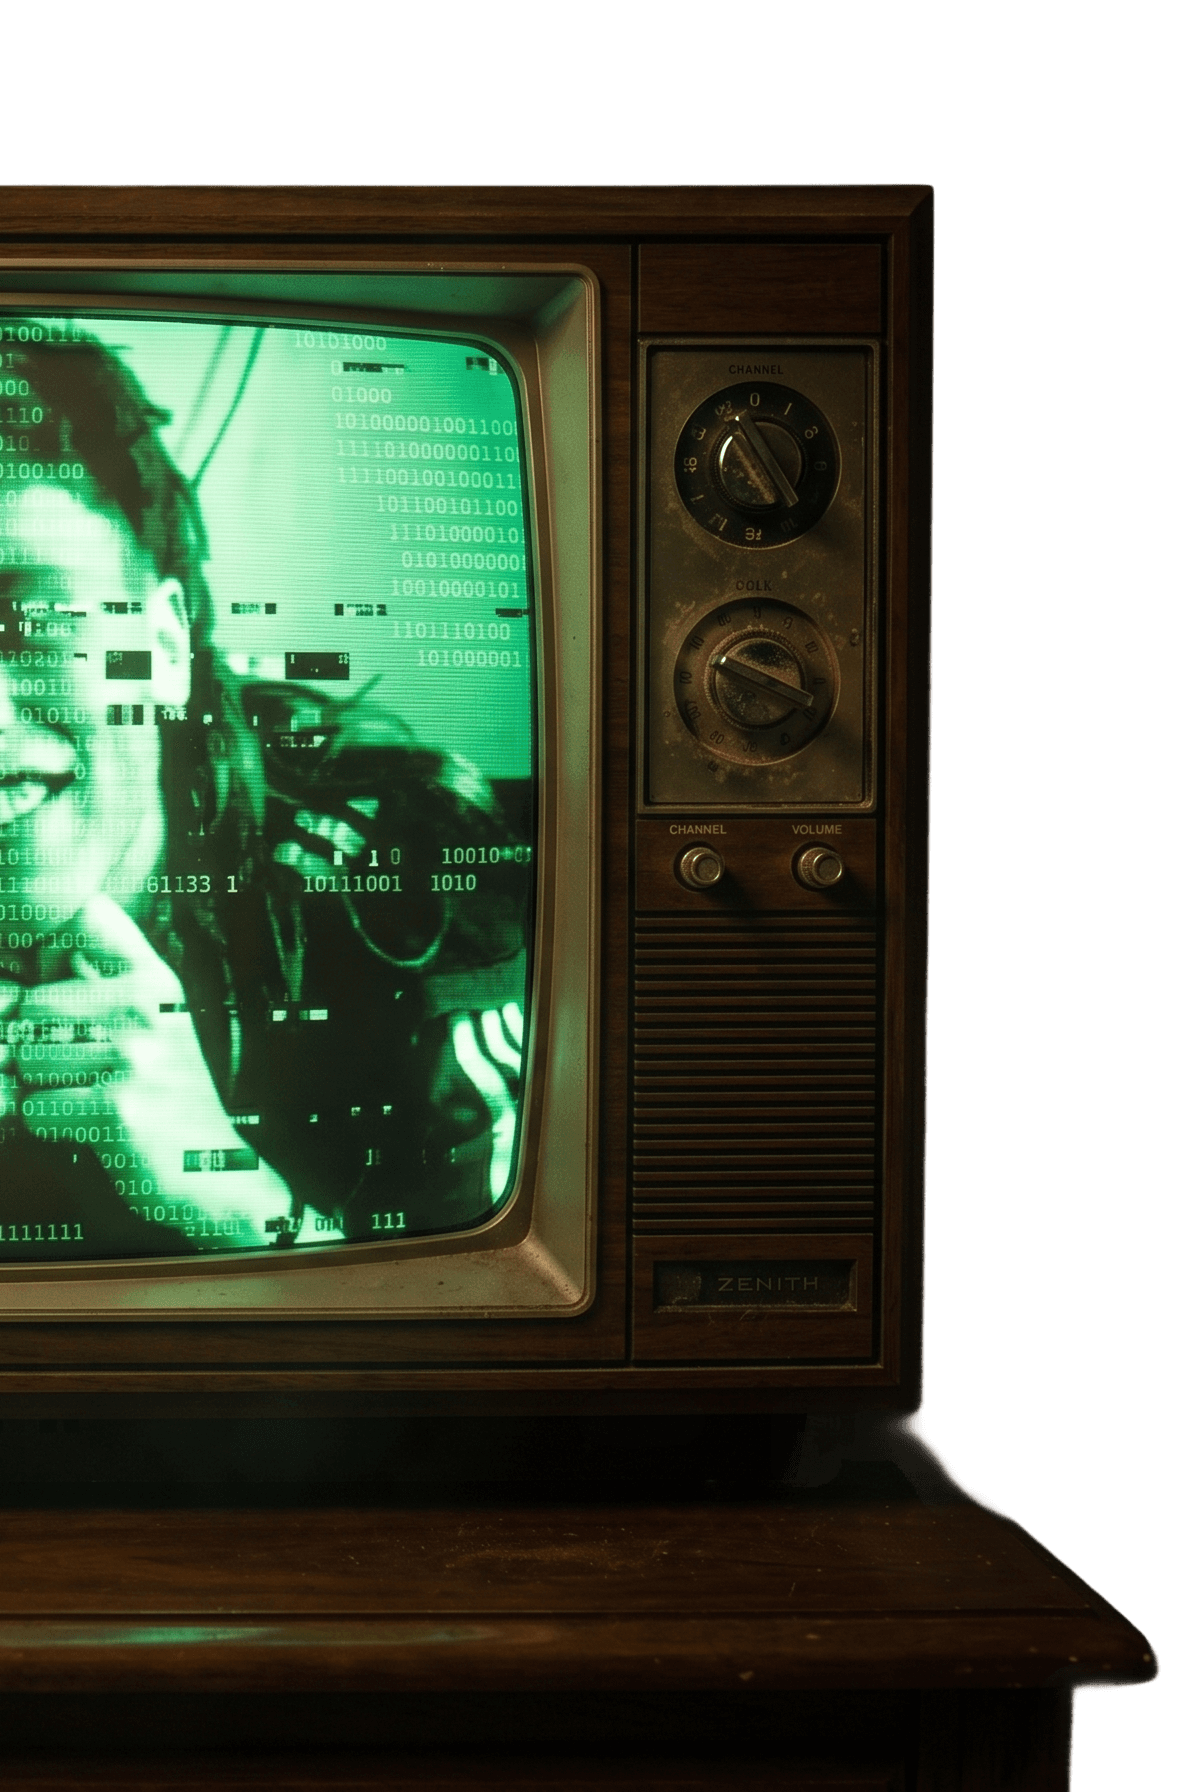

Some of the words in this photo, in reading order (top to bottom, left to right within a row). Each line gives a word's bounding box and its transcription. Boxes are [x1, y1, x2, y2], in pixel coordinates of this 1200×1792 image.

[729, 364, 784, 375] CHANNEL
[331, 386, 392, 404] 01000
[669, 824, 727, 835] CHANNEL
[791, 824, 843, 835] VOLUME
[303, 874, 402, 893] 10111001
[431, 873, 477, 891] 1010
[370, 1211, 407, 1230] 111
[717, 1276, 819, 1292] ZENITH
